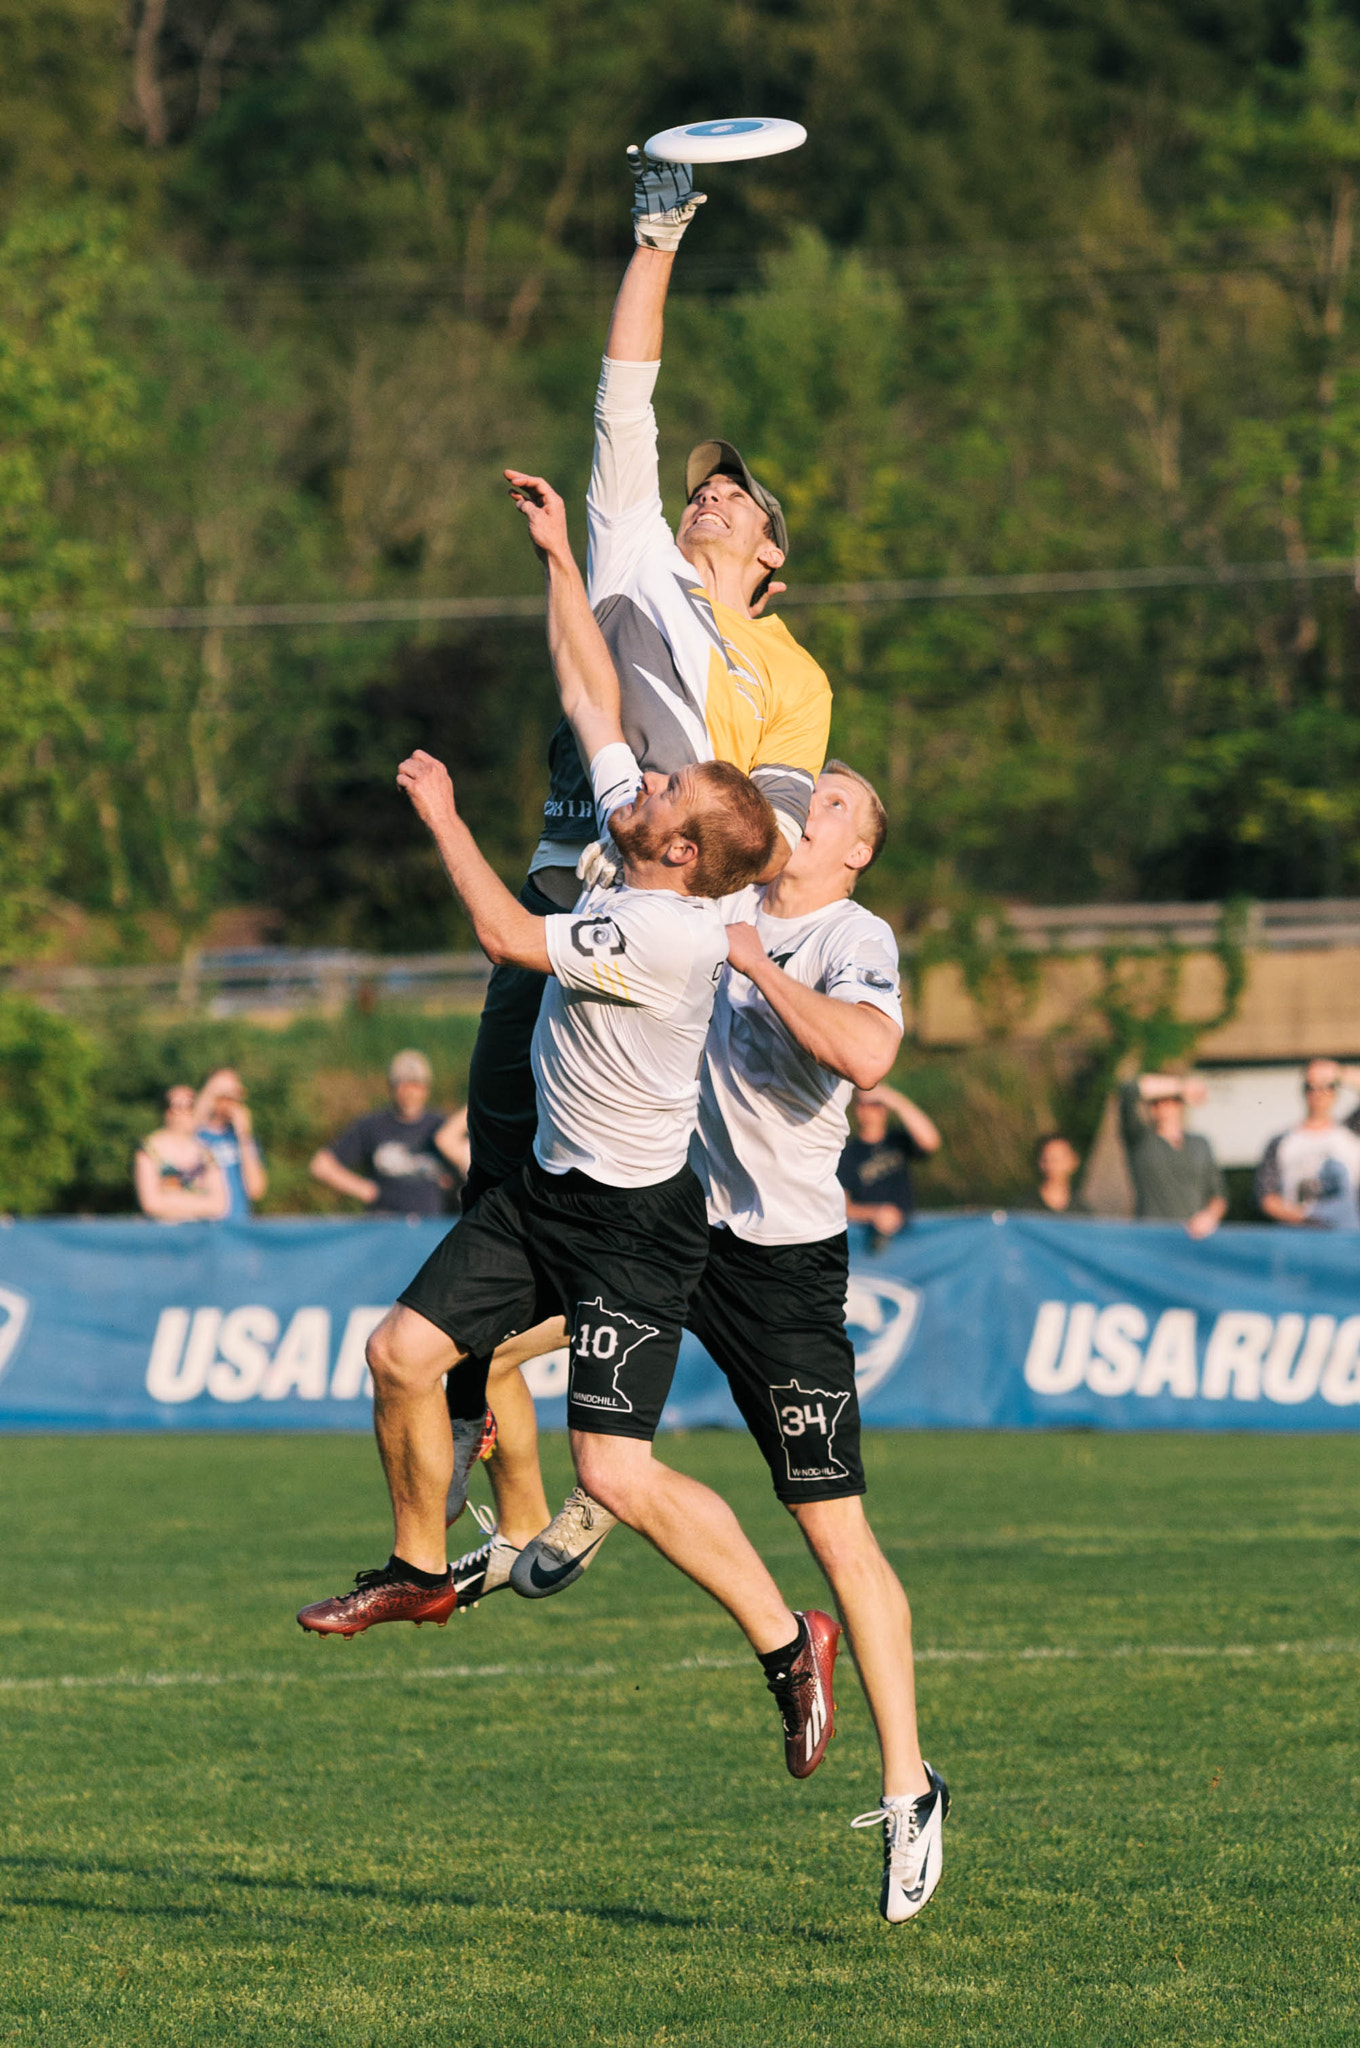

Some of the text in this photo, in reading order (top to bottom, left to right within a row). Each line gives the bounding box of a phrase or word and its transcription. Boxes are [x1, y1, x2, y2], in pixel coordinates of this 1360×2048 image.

[576, 1323, 619, 1360] 10
[572, 1391, 619, 1408] WINDCHILL
[781, 1402, 828, 1437] 34
